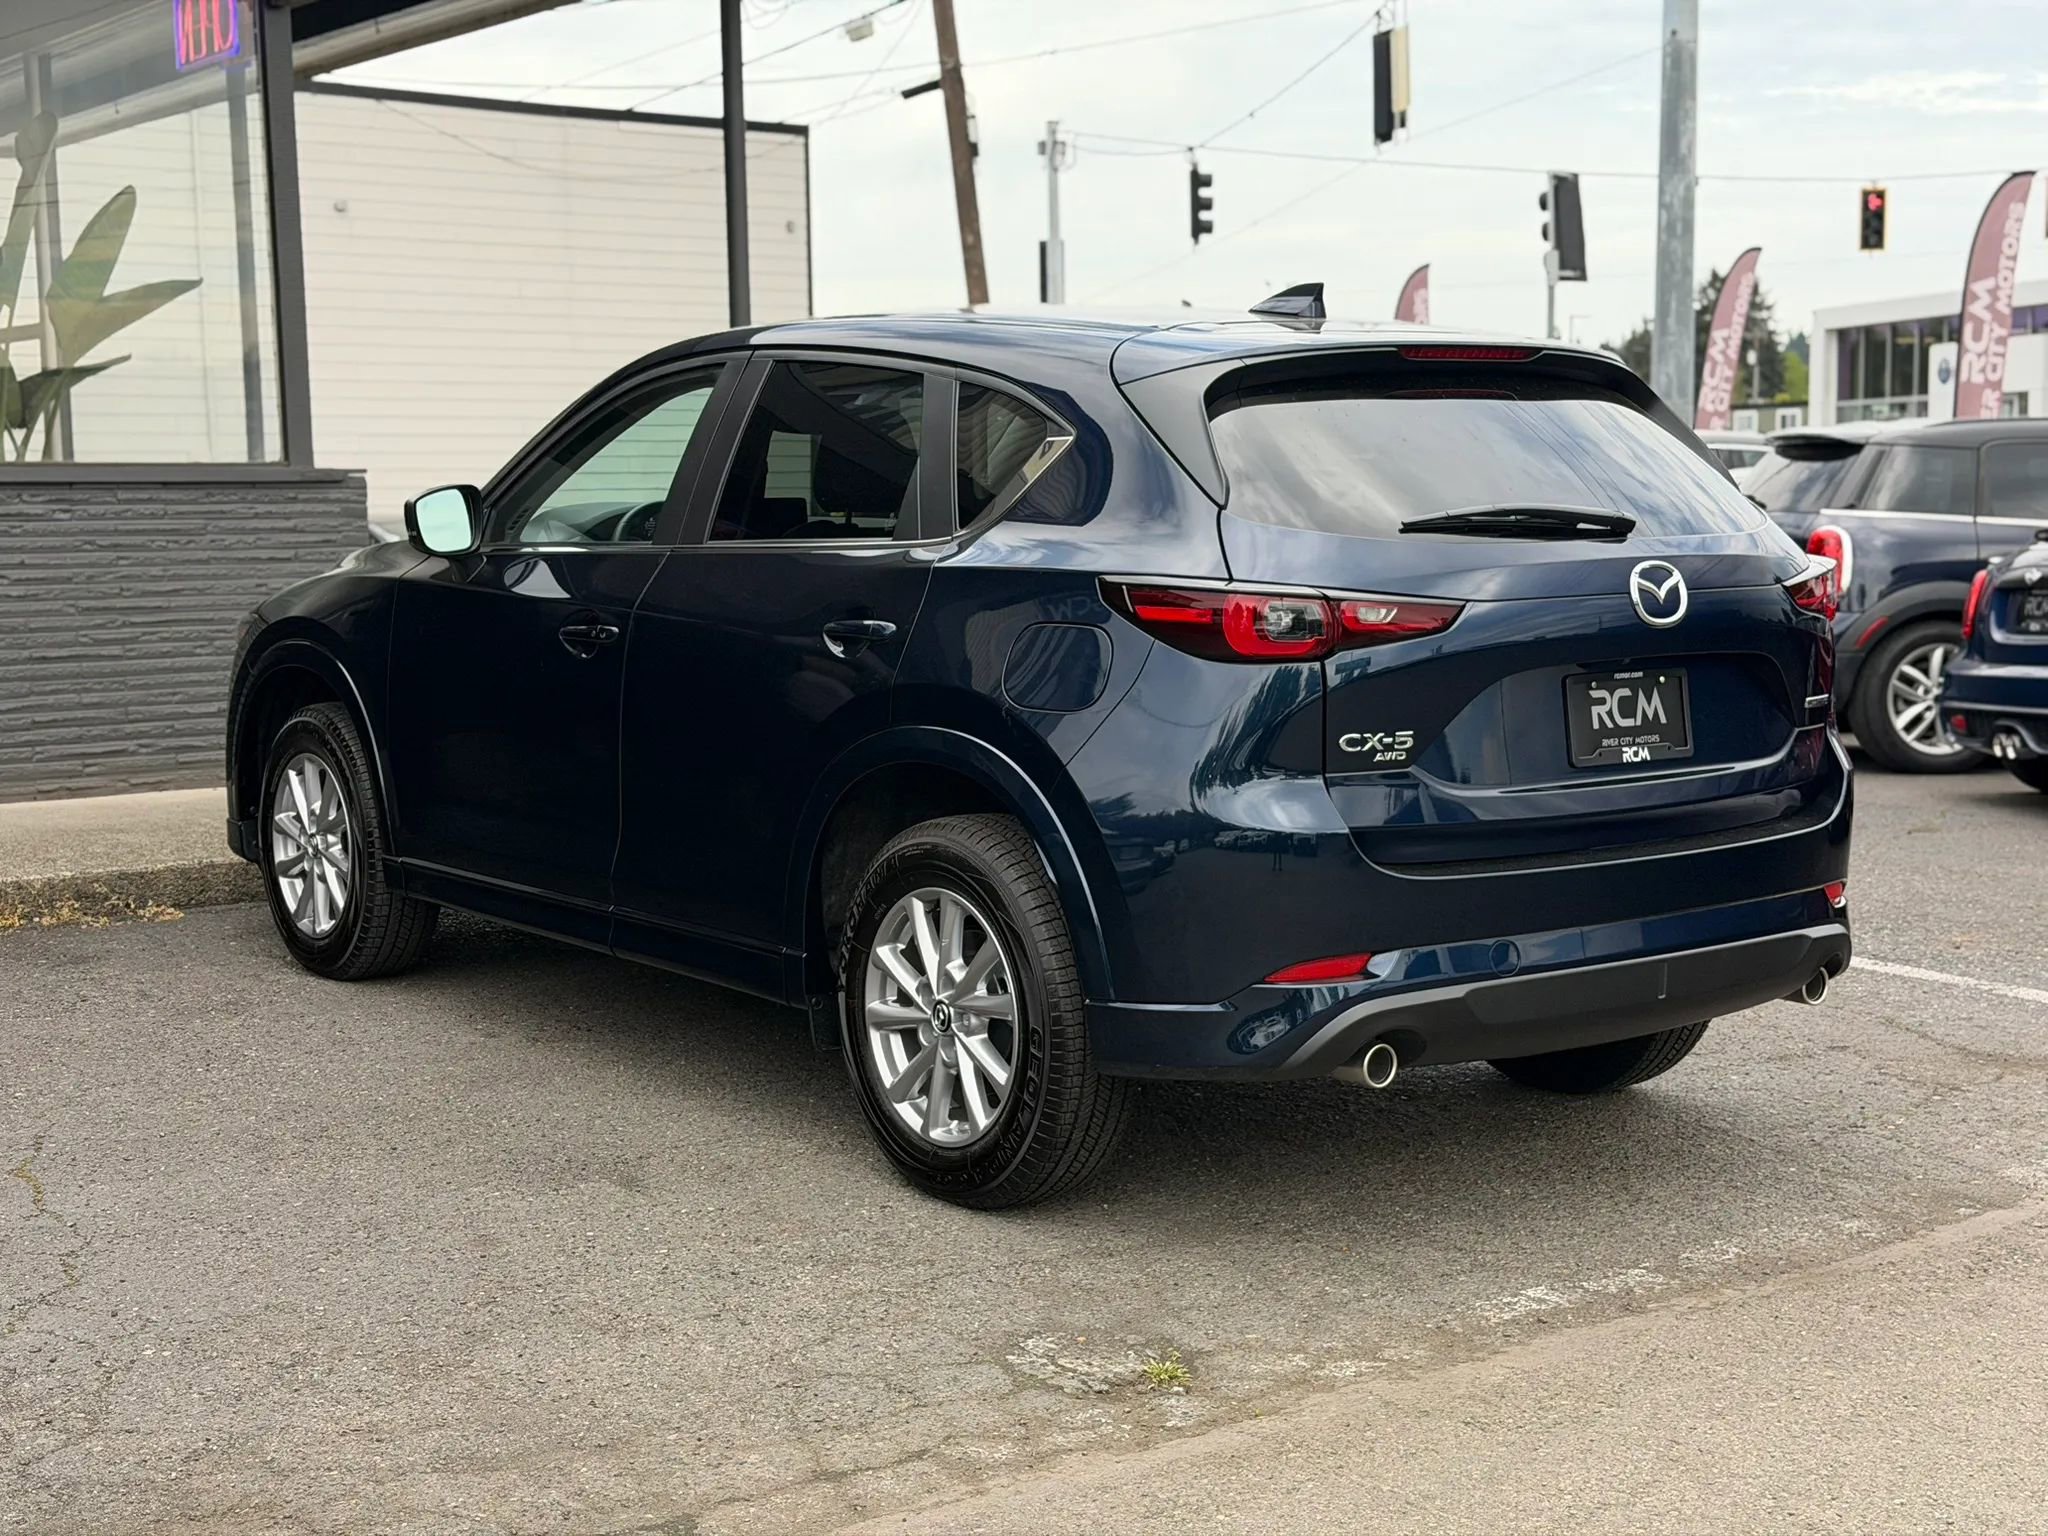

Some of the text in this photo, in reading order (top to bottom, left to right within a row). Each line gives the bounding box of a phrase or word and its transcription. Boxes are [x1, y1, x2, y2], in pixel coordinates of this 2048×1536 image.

[1994, 201, 2026, 316] MOTORS
[1961, 276, 1997, 384] RCM
[1698, 327, 1730, 413] RCM
[1588, 686, 1667, 730] RCM
[1338, 730, 1414, 752] CX-5
[1373, 751, 1407, 762] AWD
[1602, 734, 1660, 746] RIVER CITY MOTORS
[1621, 746, 1651, 763] RCM
